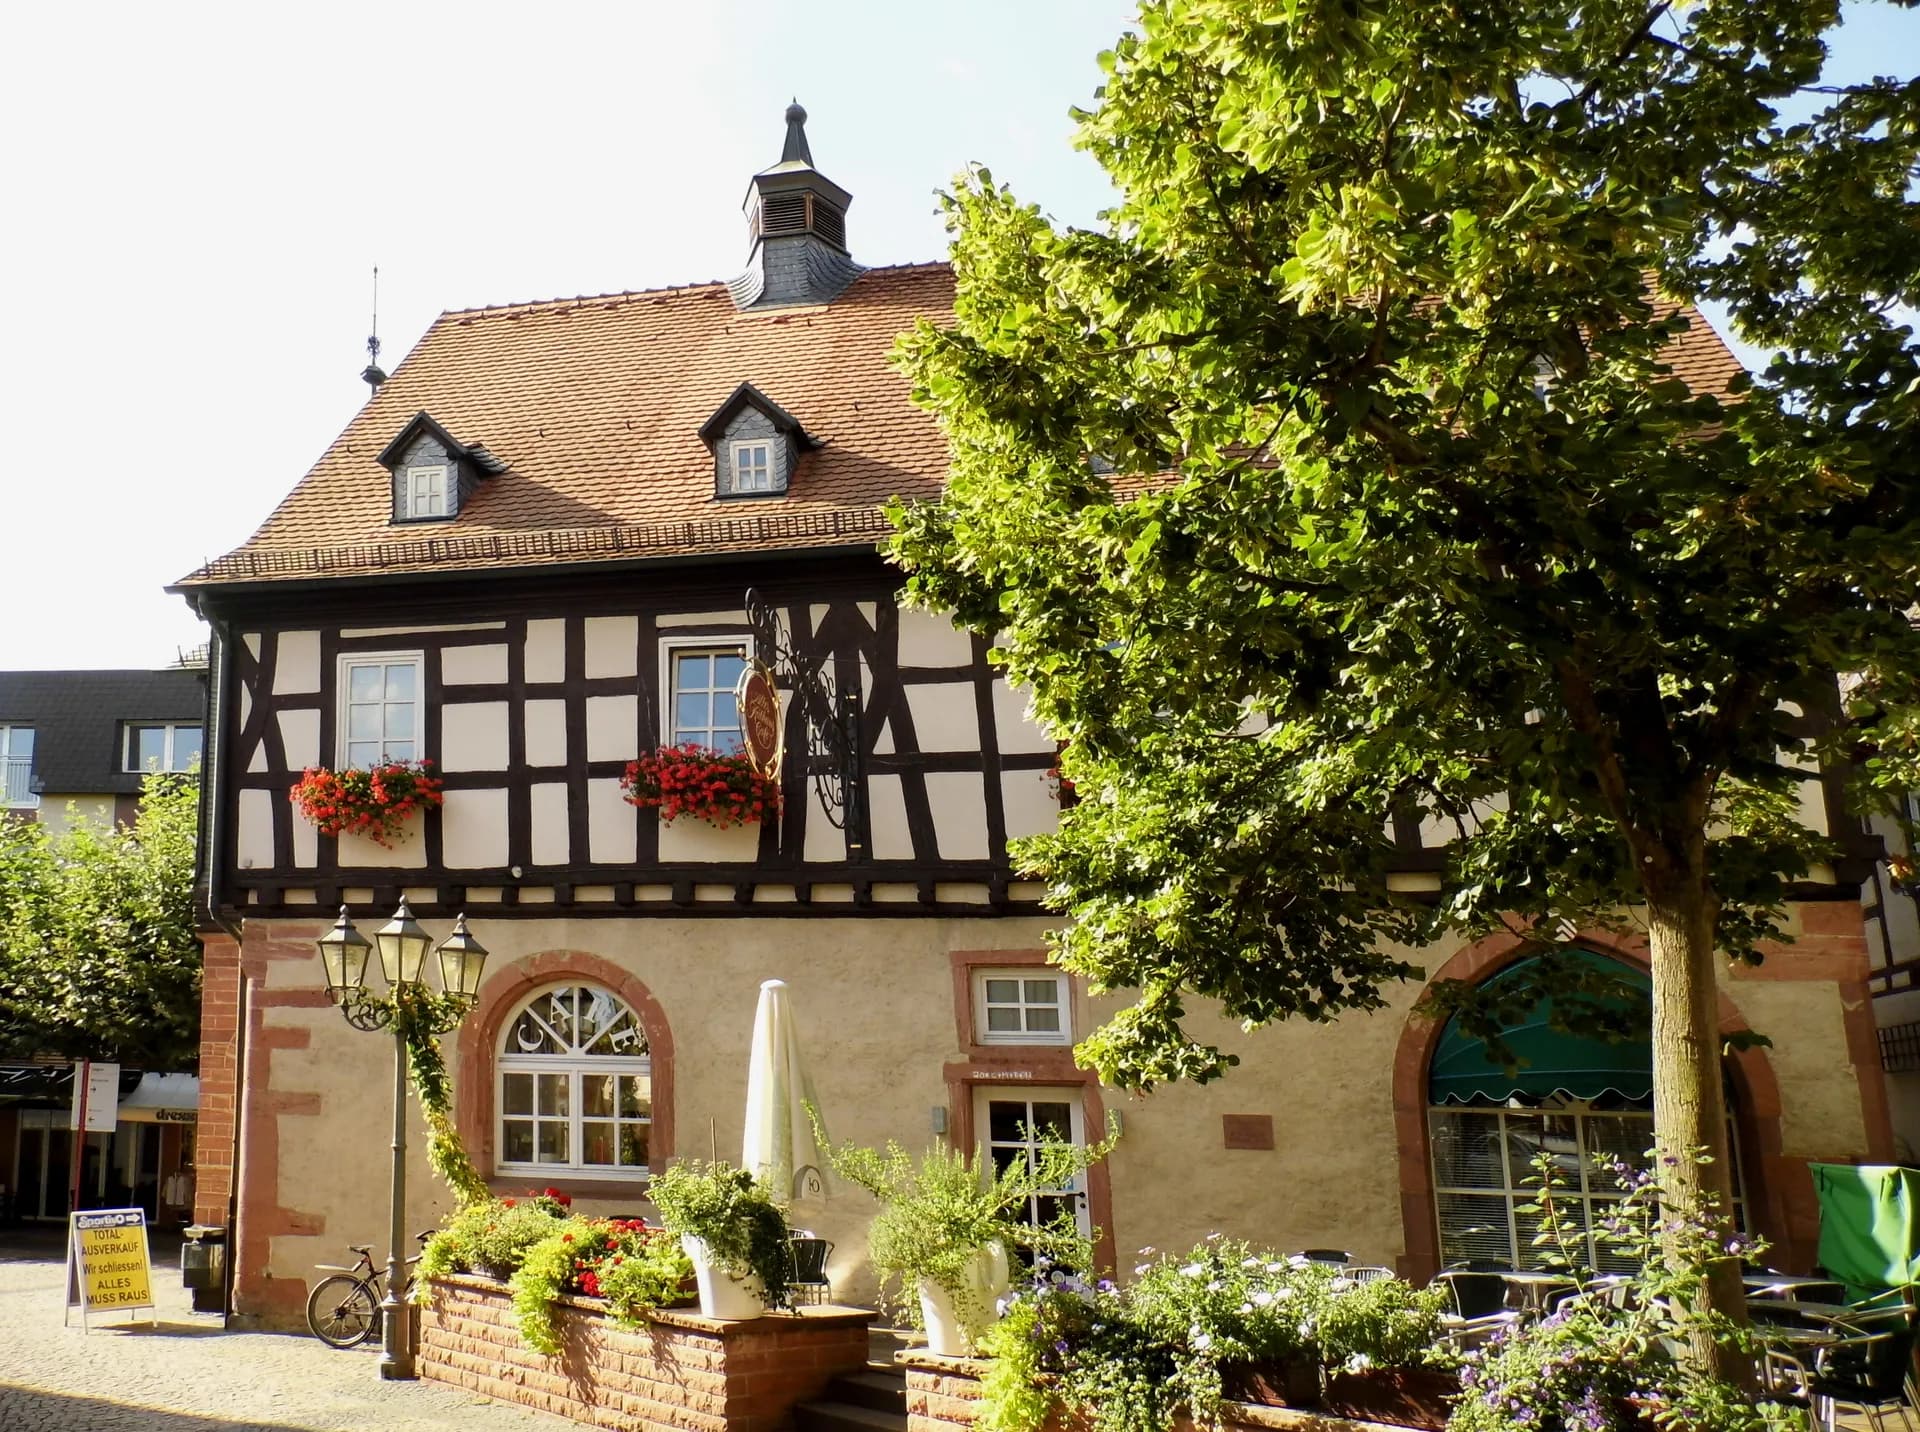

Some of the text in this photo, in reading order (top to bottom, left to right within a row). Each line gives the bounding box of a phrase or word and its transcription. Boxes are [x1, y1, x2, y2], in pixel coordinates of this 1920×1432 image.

[93, 1229, 124, 1241] TOTAL-
[81, 1241, 139, 1257] AUSVERKAUF
[83, 1259, 143, 1275] Wir schliessen!
[97, 1277, 131, 1290] ALLES
[86, 1289, 148, 1305] MUSS RAUS
